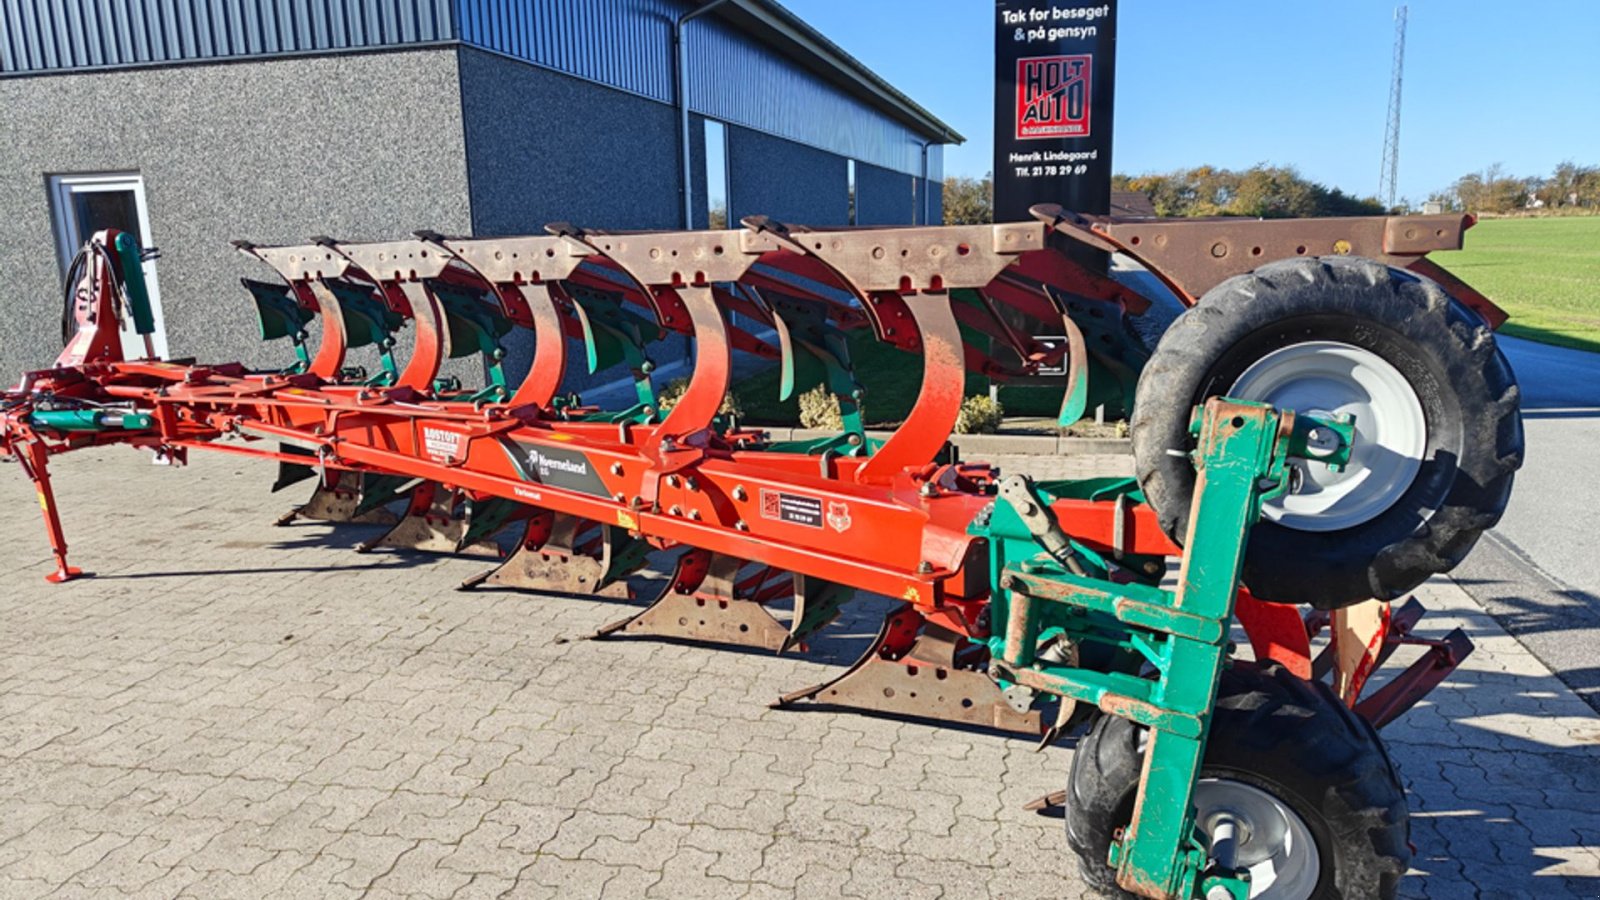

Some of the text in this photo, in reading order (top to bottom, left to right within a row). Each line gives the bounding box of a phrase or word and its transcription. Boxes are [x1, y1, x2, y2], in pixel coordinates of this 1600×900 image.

[1002, 4, 1109, 24] Tak for besøget
[1014, 26, 1097, 43] & på gensyn
[1025, 60, 1085, 104] HOLT
[1022, 79, 1085, 123] AUTO
[1009, 149, 1097, 163] Henrik Lindegaard
[1015, 164, 1087, 177] Tlf. 21 78 29 69
